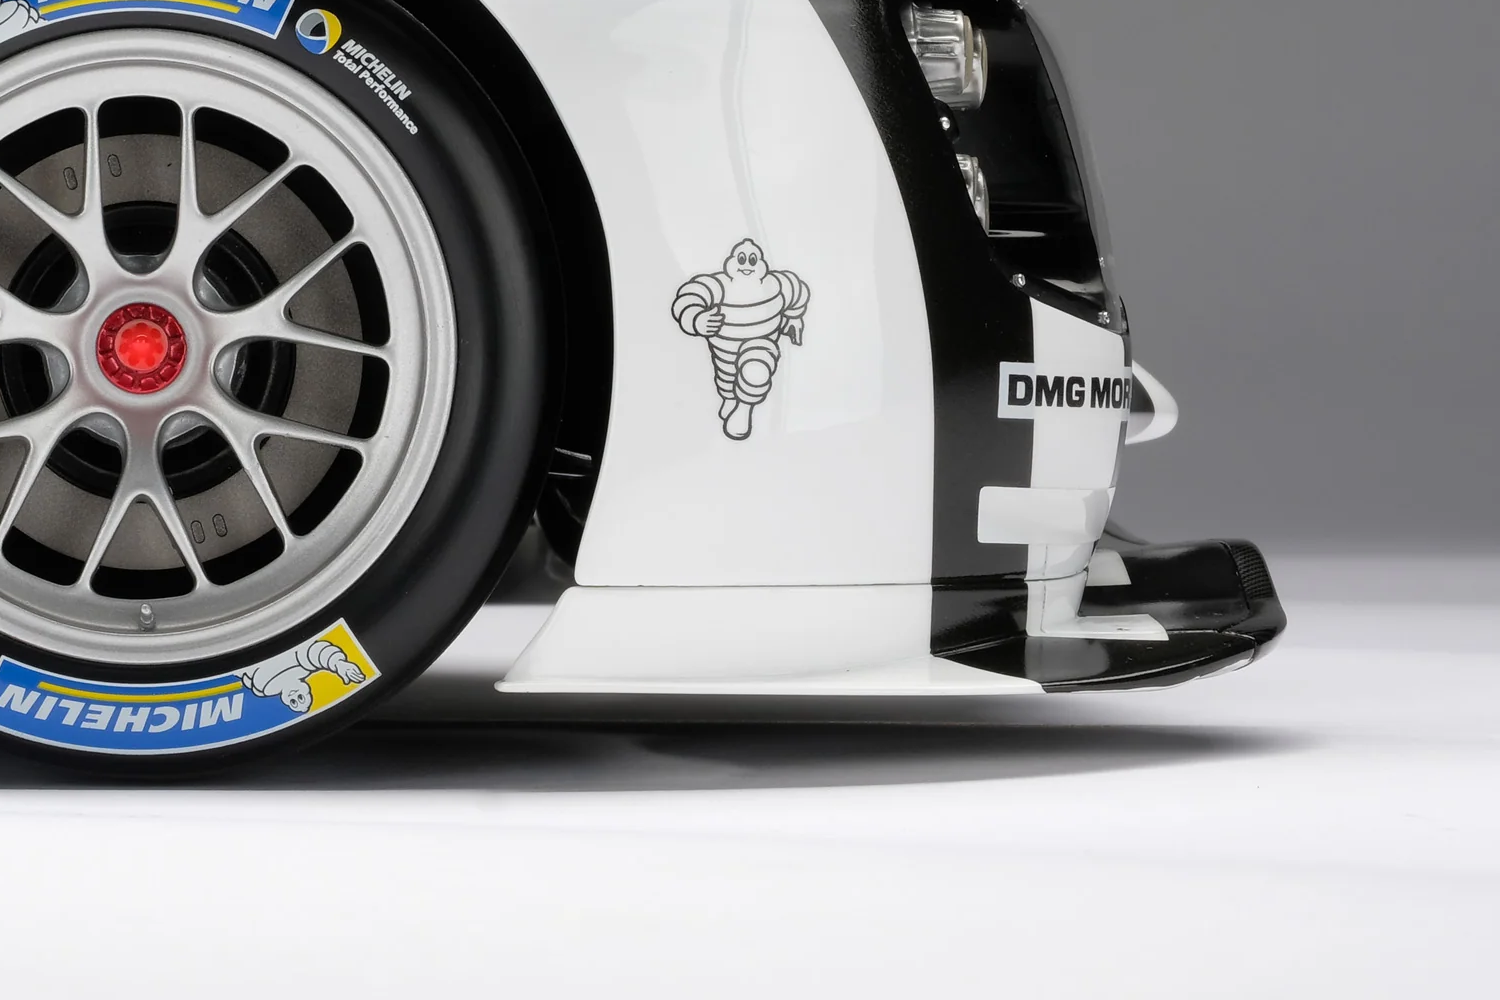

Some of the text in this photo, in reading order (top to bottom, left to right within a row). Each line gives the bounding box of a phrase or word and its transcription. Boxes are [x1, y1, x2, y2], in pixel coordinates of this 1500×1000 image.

[332, 49, 419, 135] Total Performance
[341, 39, 412, 101] MICHELIN
[1007, 374, 1086, 408] DMG
